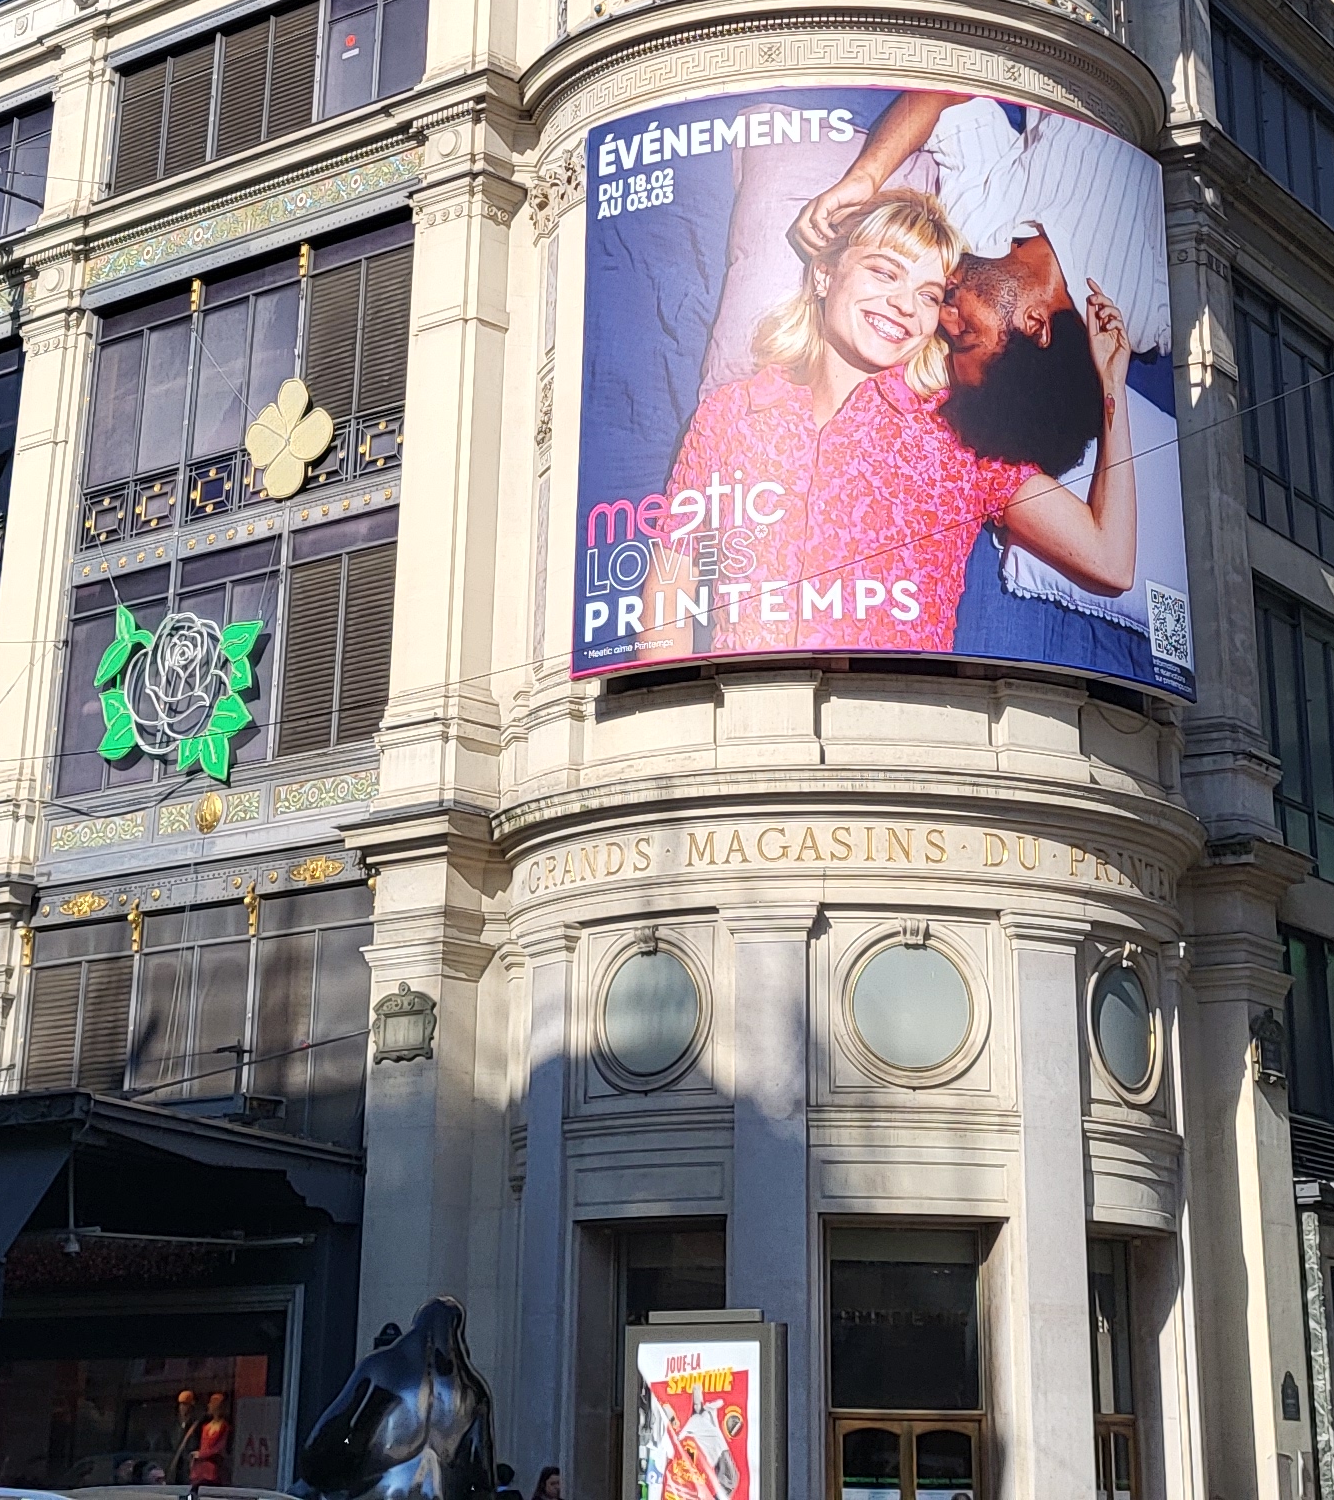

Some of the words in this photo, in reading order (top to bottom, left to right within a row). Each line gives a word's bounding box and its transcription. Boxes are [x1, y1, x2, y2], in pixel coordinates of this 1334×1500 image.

[598, 108, 855, 177] ÉVÉNEMENTS
[597, 198, 622, 220] AU
[626, 185, 674, 213] 03.03
[598, 179, 624, 202] DU
[627, 167, 674, 196] 18.02
[586, 469, 786, 547] meetic
[583, 578, 921, 642] PRINTEMPS
[528, 835, 652, 895] GRANDS
[685, 824, 950, 869] MAGASINS
[982, 831, 1041, 872] DU
